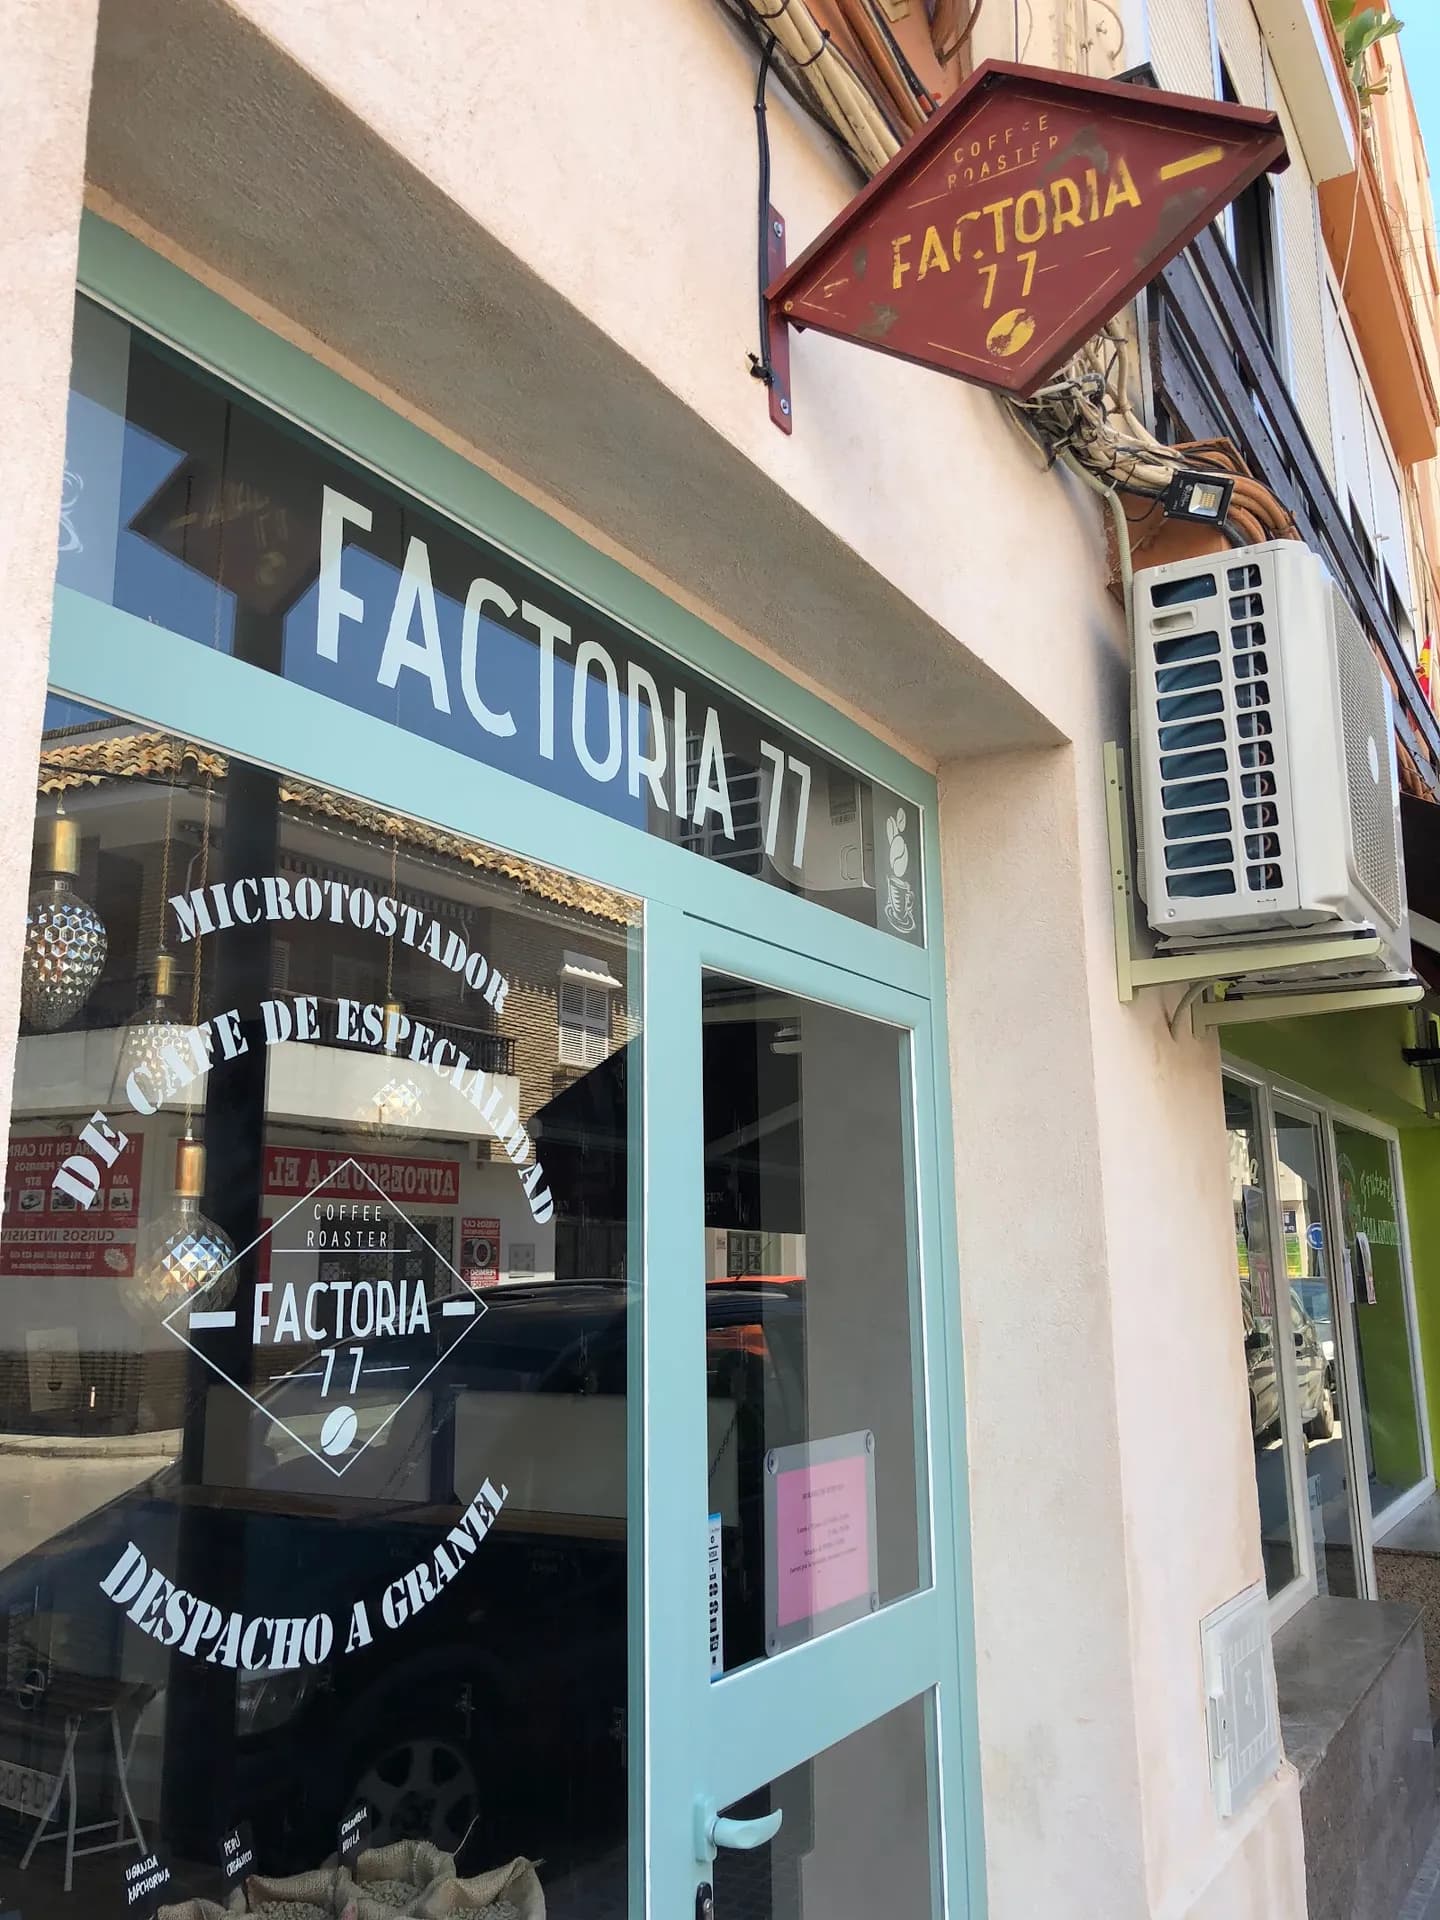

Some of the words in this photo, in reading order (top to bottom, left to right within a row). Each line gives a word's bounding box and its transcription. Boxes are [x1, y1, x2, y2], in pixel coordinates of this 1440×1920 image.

[948, 135, 1058, 190] ROASTER
[890, 156, 1142, 289] FACTORIA
[978, 250, 1038, 308] 77
[315, 485, 735, 842] FACTORIA
[758, 740, 812, 870] 77
[168, 877, 509, 1014] MICROTOSTADOR
[51, 1110, 128, 1211] DE
[125, 1008, 248, 1116] CAFE
[260, 996, 321, 1045] DE
[336, 997, 555, 1226] ESPECIALIDAD
[307, 1230, 387, 1247] ROASTER
[313, 1203, 382, 1222] COFFEE
[252, 1280, 431, 1344] FACTORIA
[320, 1347, 364, 1398] 77
[99, 1541, 334, 1671] DESPACHO
[344, 1601, 374, 1654] A
[381, 1476, 510, 1630] GRANEL
[125, 1855, 159, 1881] UGANDA
[224, 1830, 241, 1857] PERÚ
[127, 1868, 171, 1905] KAPCHORWA
